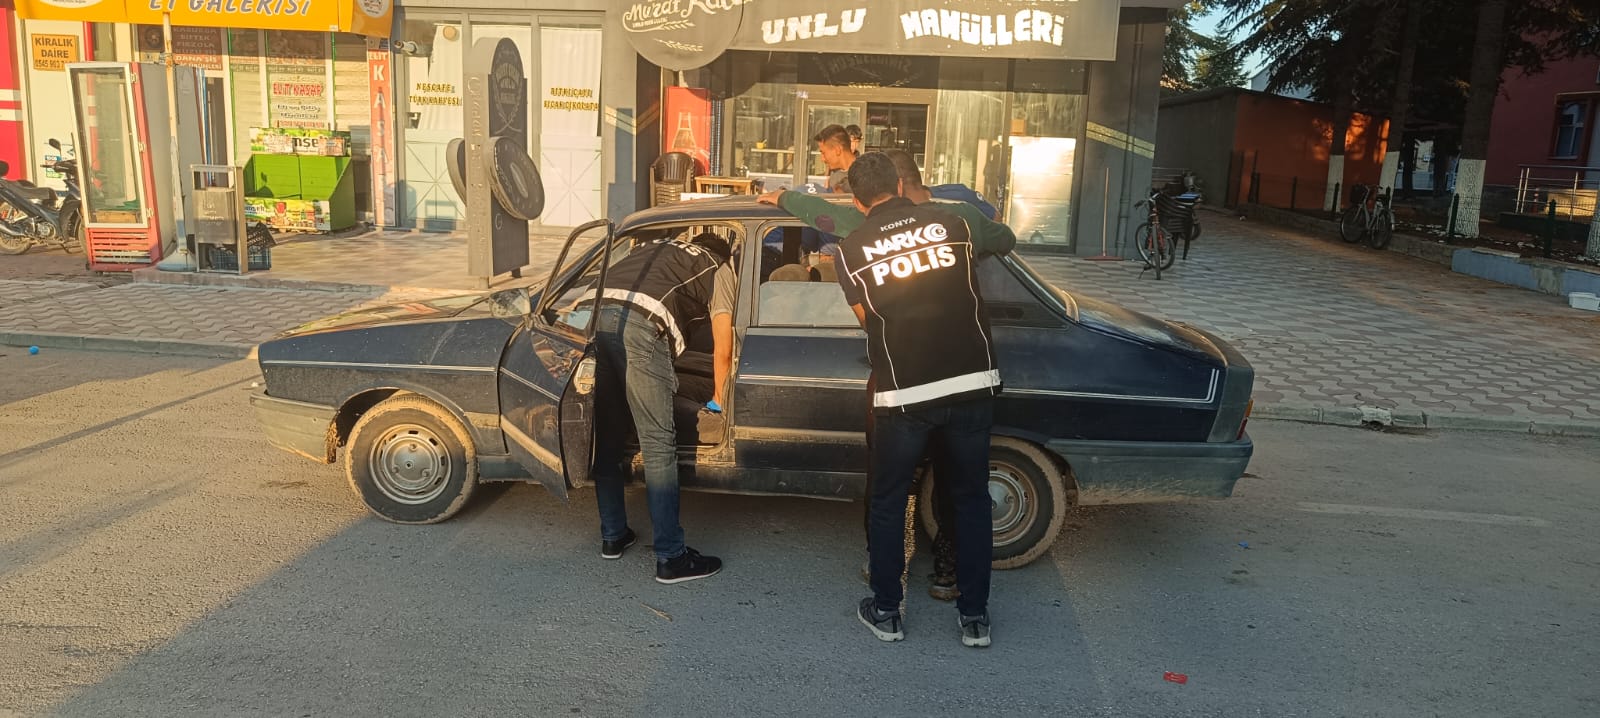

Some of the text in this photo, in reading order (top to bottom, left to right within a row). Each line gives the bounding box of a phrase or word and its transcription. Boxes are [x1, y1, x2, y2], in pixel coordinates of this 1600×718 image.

[760, 8, 1065, 46] UNLU MAMÜLLERİ
[34, 36, 73, 47] KİRALIK
[41, 48, 70, 58] DAİRE
[880, 217, 917, 232] KONYA
[862, 223, 949, 262] NARKO
[871, 245, 956, 286] POLİS
